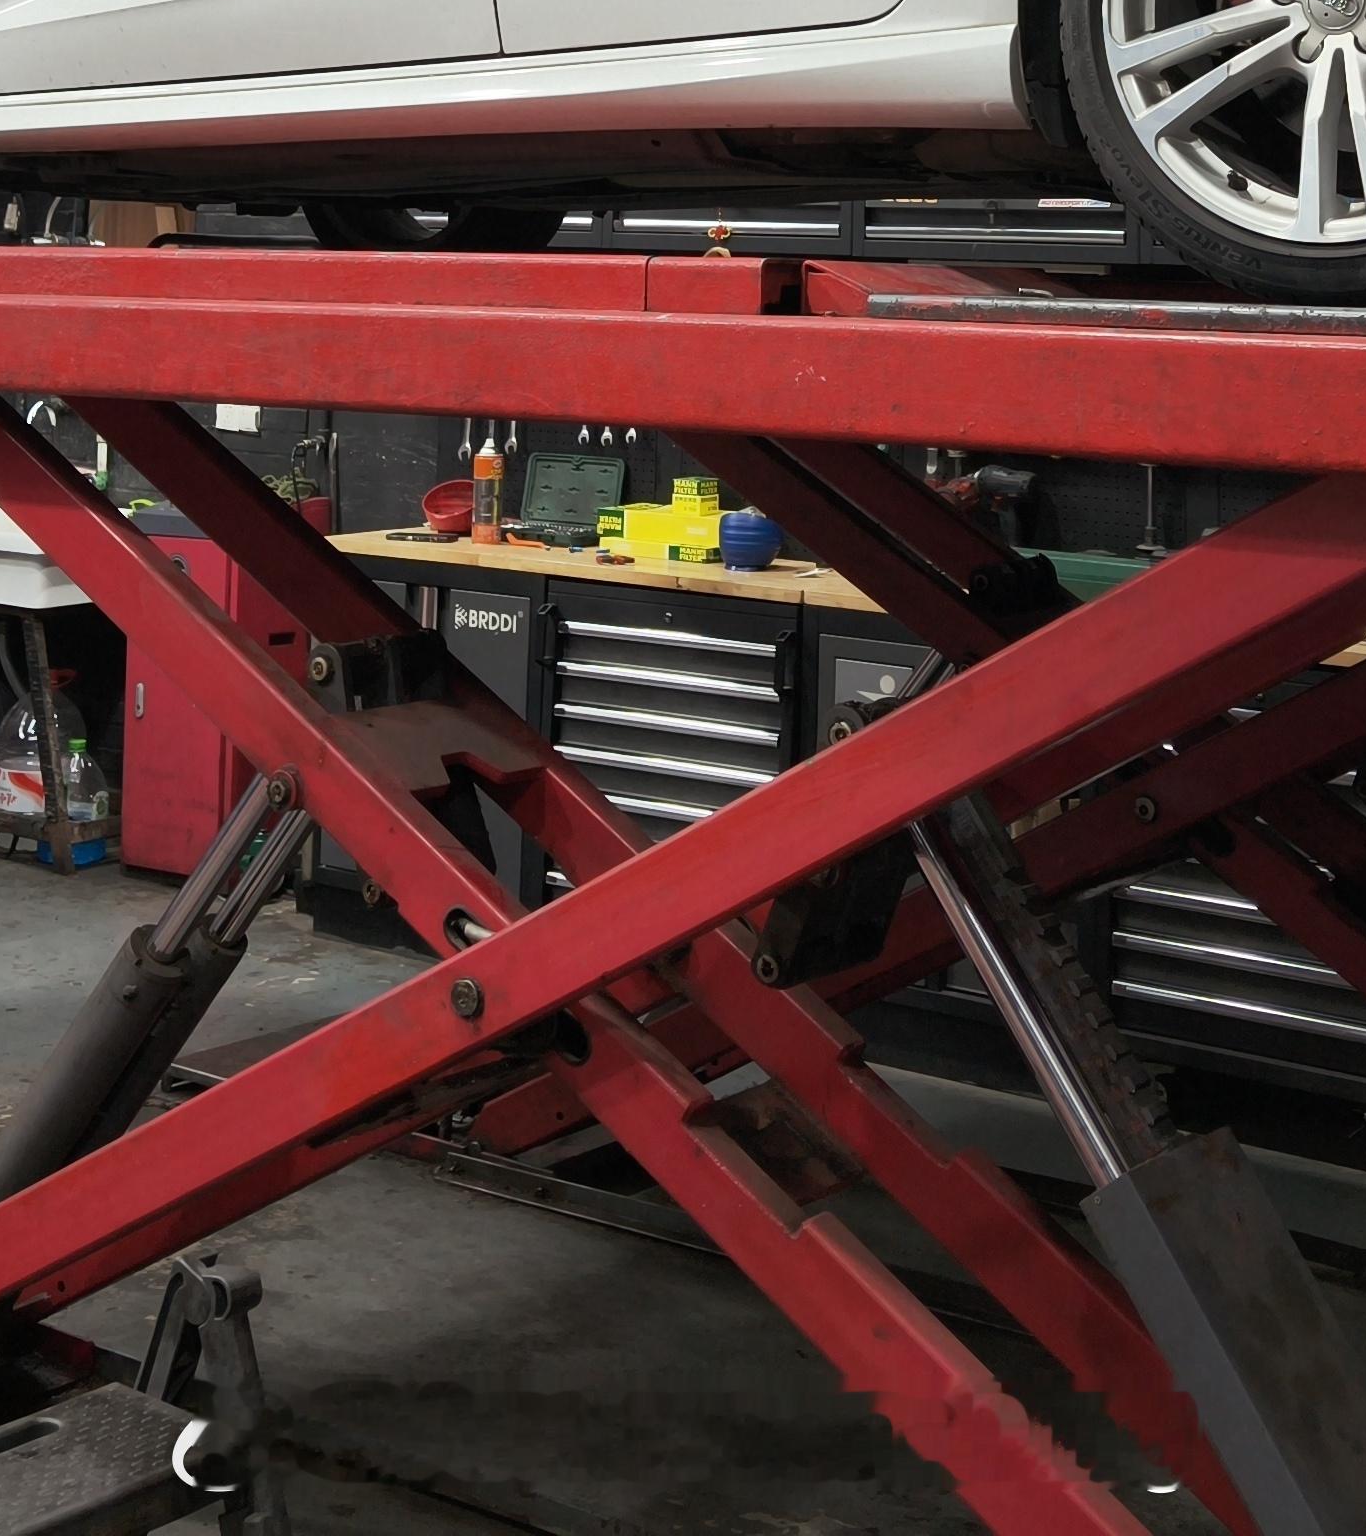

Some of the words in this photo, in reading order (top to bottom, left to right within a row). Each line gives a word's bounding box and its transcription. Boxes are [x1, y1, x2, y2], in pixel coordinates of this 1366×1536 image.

[674, 479, 699, 487] MANN
[701, 480, 718, 488] MANN
[674, 487, 698, 495] FILTER
[679, 547, 706, 555] MANN
[679, 554, 704, 562] FILTER
[468, 609, 518, 634] BRDDI
